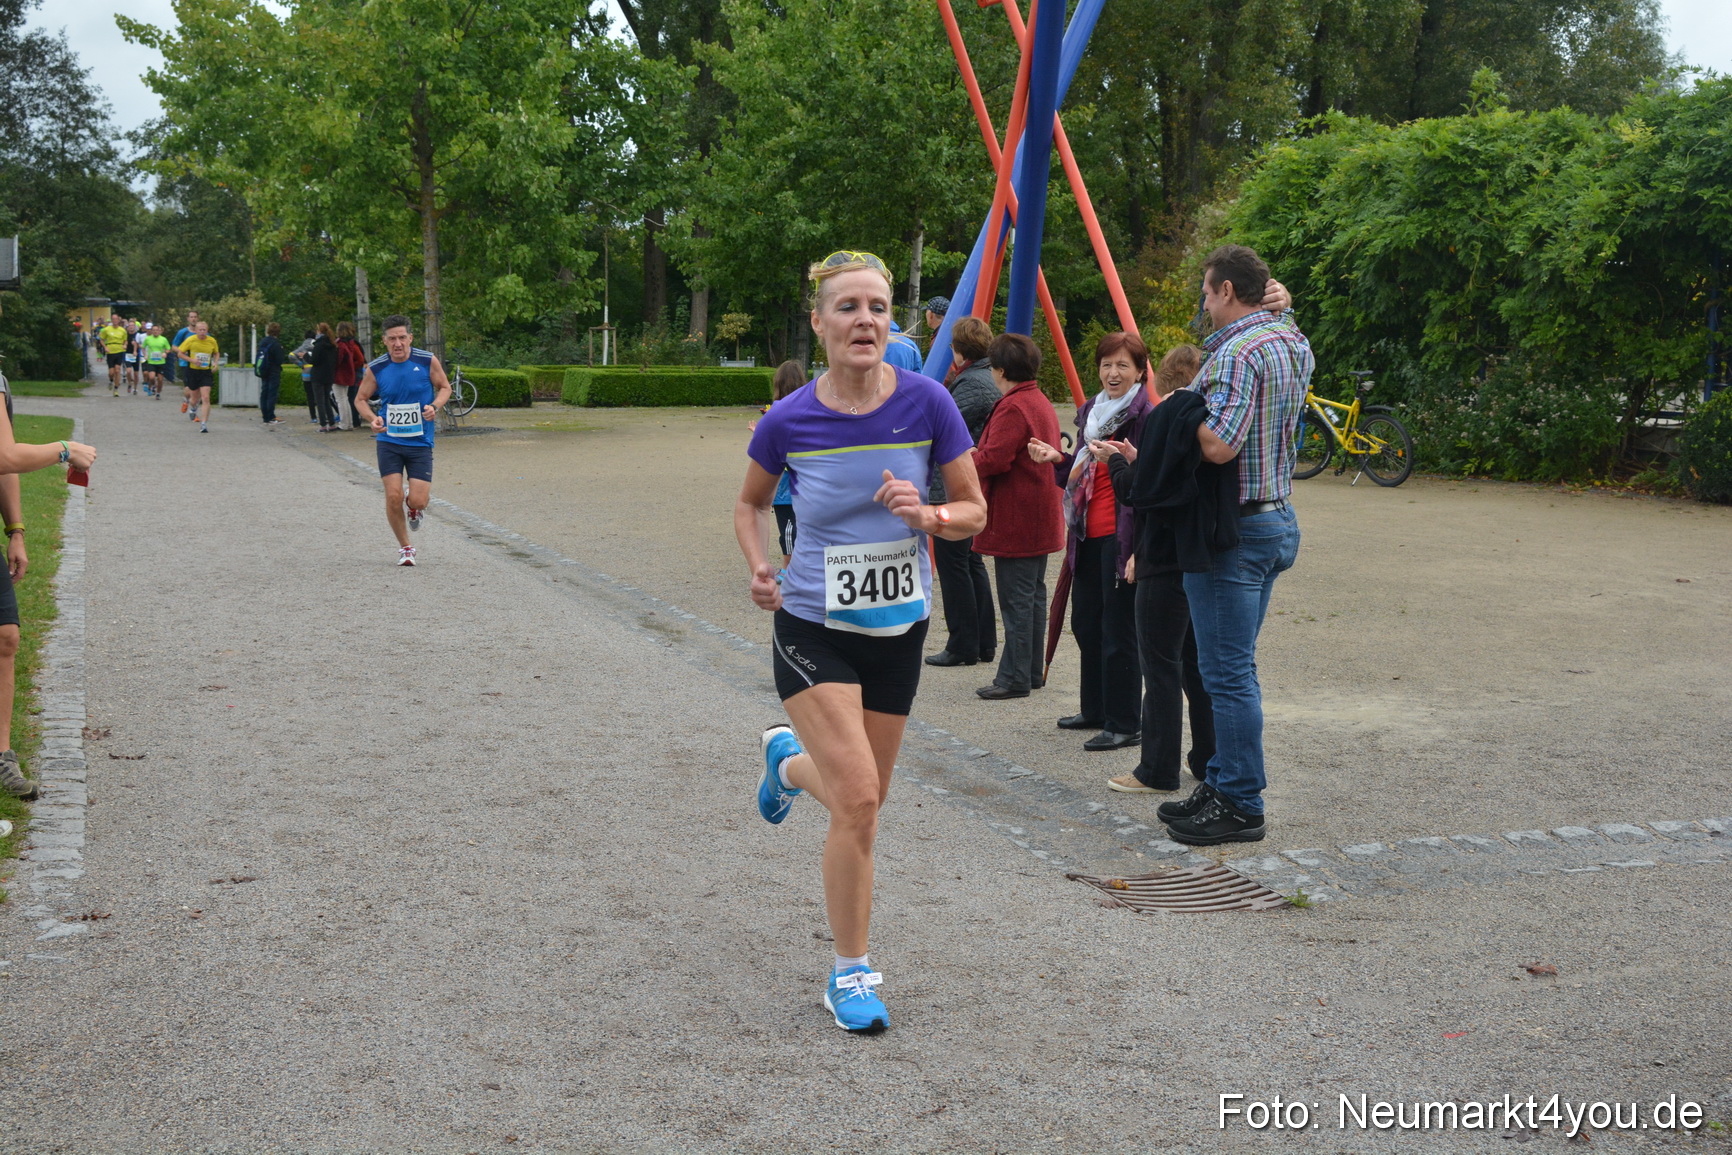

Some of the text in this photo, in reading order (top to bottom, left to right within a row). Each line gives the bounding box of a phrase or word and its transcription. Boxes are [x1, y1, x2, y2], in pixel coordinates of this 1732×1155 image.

[389, 411, 418, 424] 2220
[826, 550, 908, 566] PARTL Neumarkt
[837, 562, 914, 606] 3403
